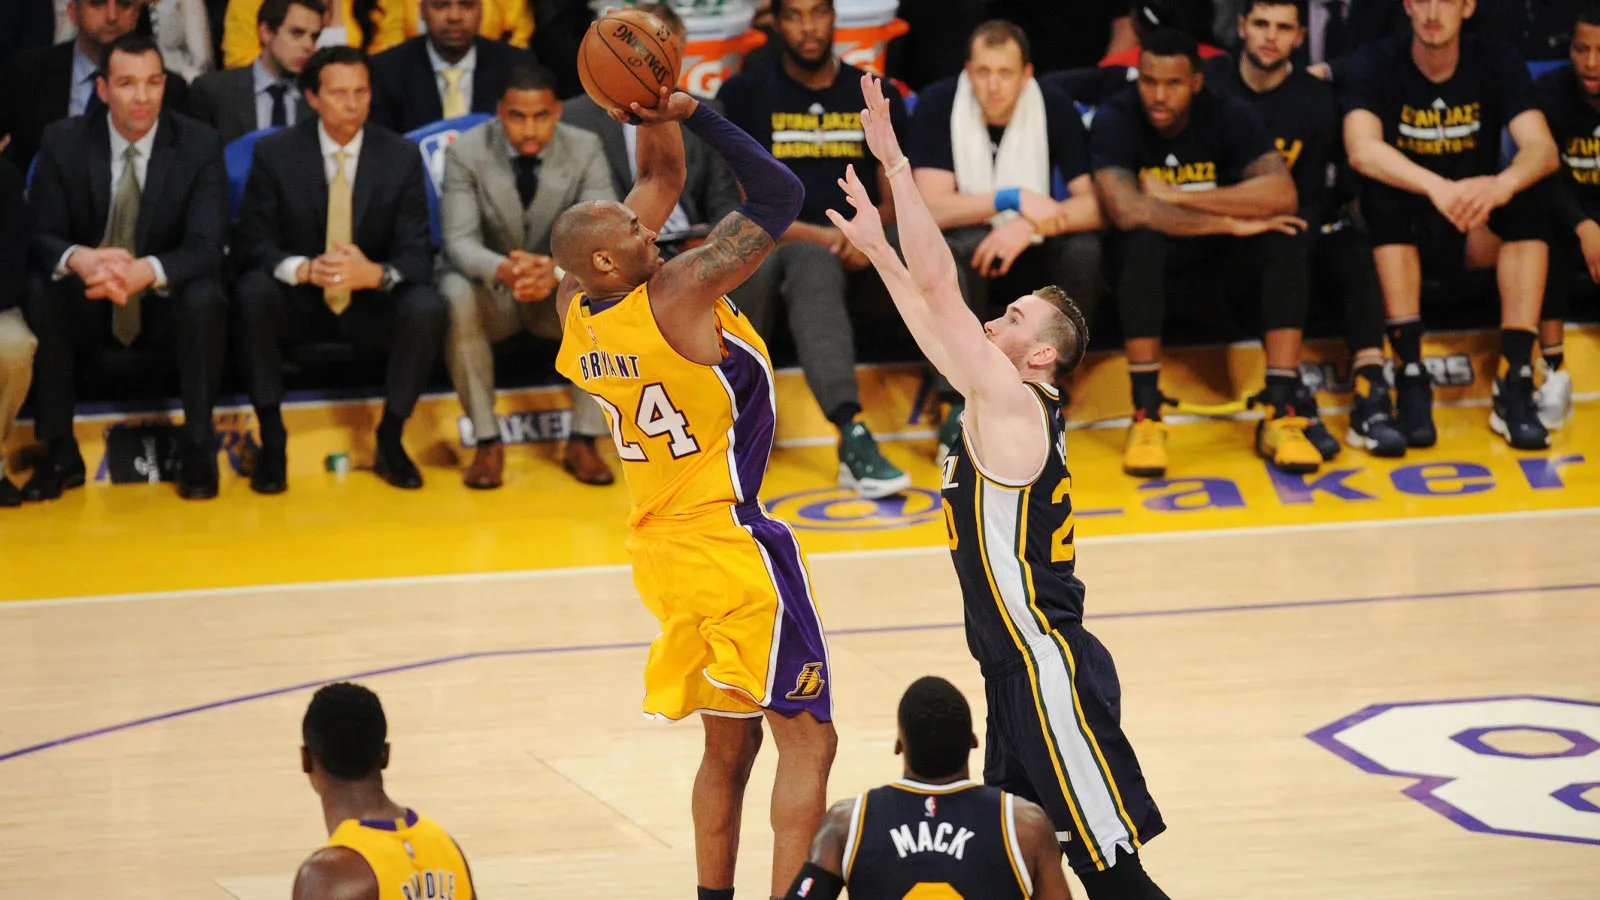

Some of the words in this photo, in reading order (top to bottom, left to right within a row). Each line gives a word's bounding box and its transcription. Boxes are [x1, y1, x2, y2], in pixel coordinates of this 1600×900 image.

[578, 350, 641, 384] BRYANT
[589, 382, 701, 462] 24
[889, 821, 976, 861] MACK
